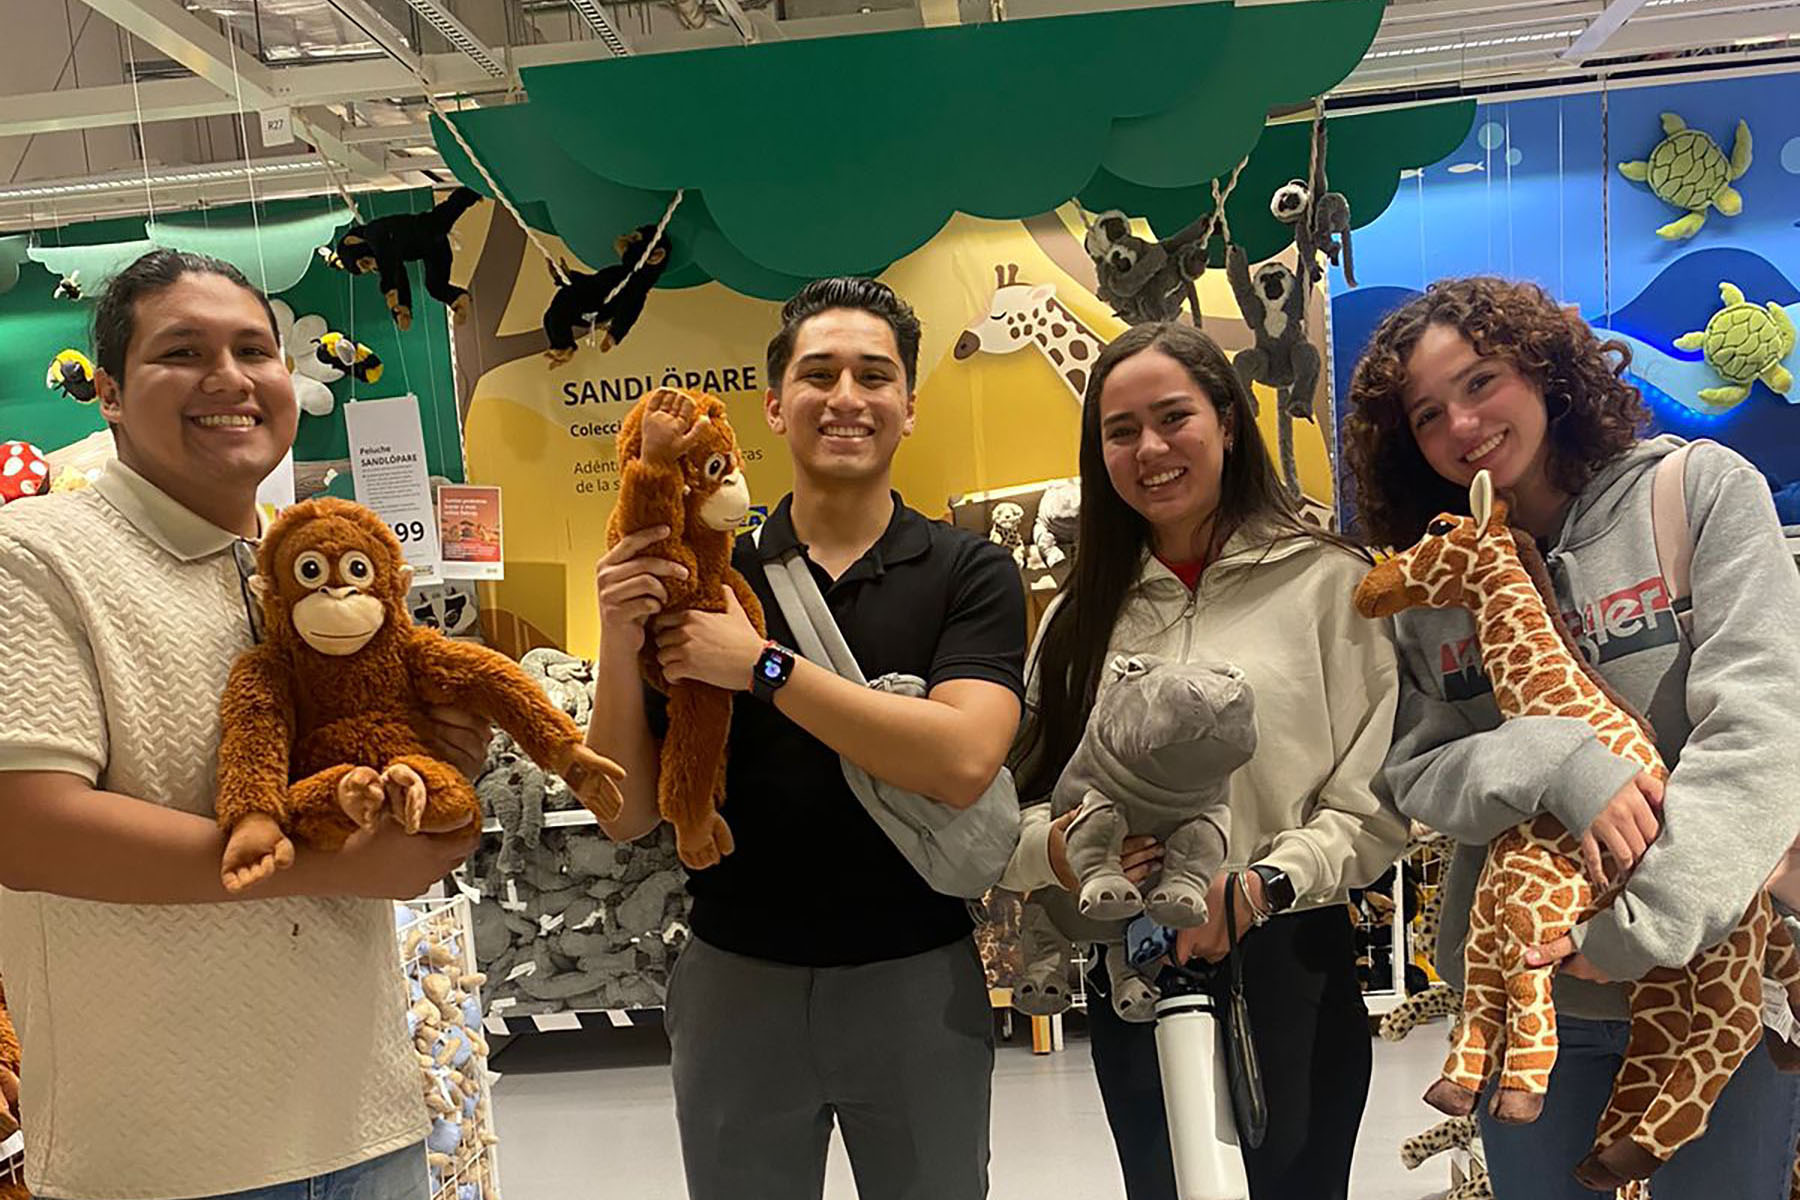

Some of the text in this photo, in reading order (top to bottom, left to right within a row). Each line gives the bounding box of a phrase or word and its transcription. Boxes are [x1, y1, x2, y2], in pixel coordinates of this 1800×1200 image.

[570, 420, 622, 437] Colecci
[574, 461, 619, 475] Adént
[576, 480, 593, 494] de
[597, 479, 610, 491] la
[388, 521, 424, 543] 99
